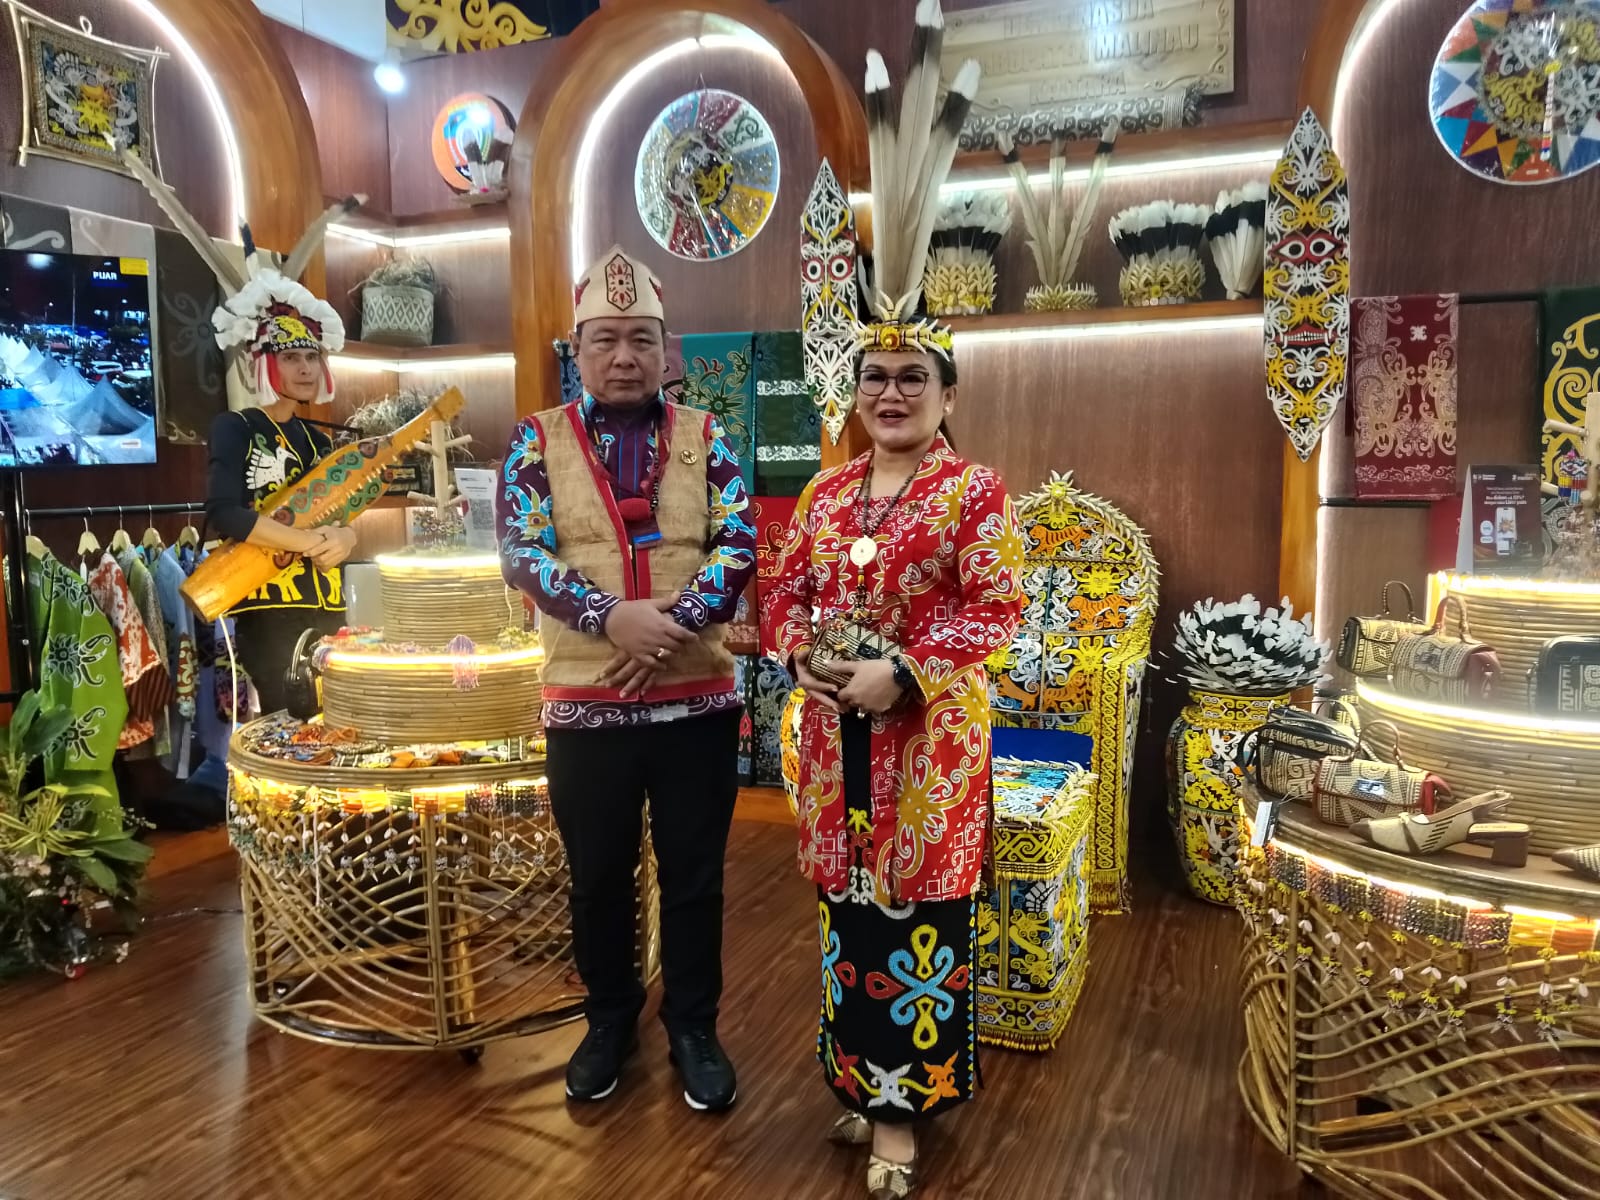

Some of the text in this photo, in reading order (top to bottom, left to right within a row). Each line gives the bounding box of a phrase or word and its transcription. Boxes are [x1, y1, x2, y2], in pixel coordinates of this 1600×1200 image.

[1004, 0, 1155, 40] DENASDA
[970, 23, 1199, 79] ABUPATEN MALINAU
